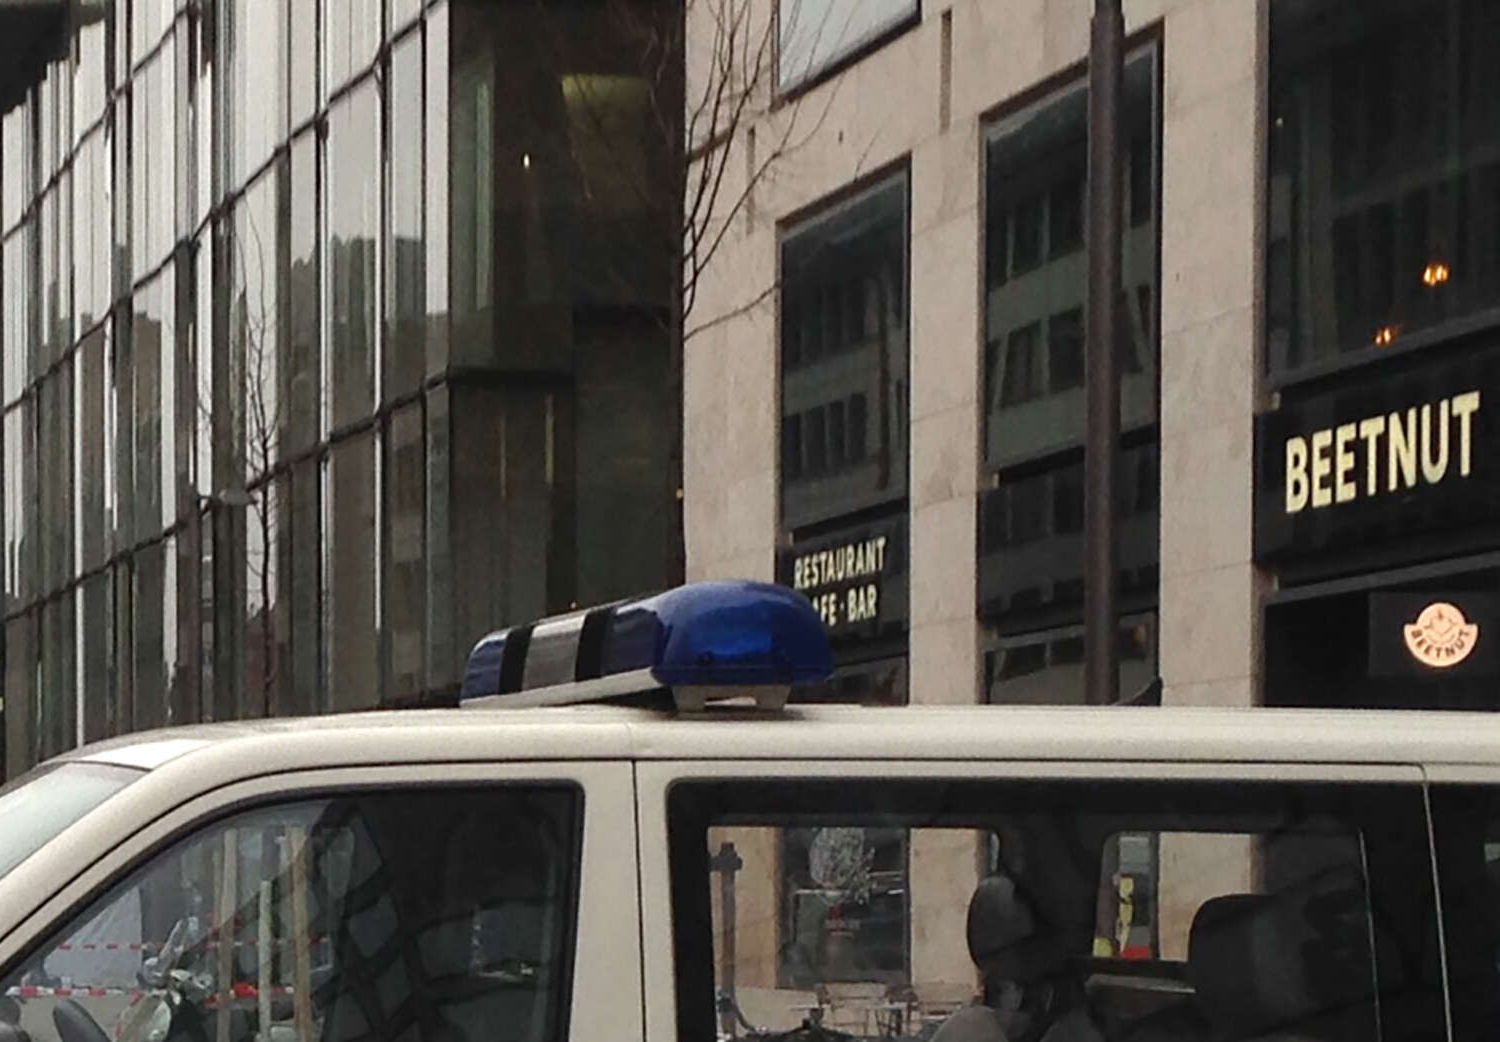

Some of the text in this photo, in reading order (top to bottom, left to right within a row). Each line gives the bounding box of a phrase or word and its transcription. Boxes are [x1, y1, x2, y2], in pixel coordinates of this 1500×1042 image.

[1286, 390, 1480, 513] BEETNUT
[794, 536, 886, 589] RESTAURANT
[847, 584, 877, 622] BAR
[1411, 628, 1470, 658] BEETNUT
